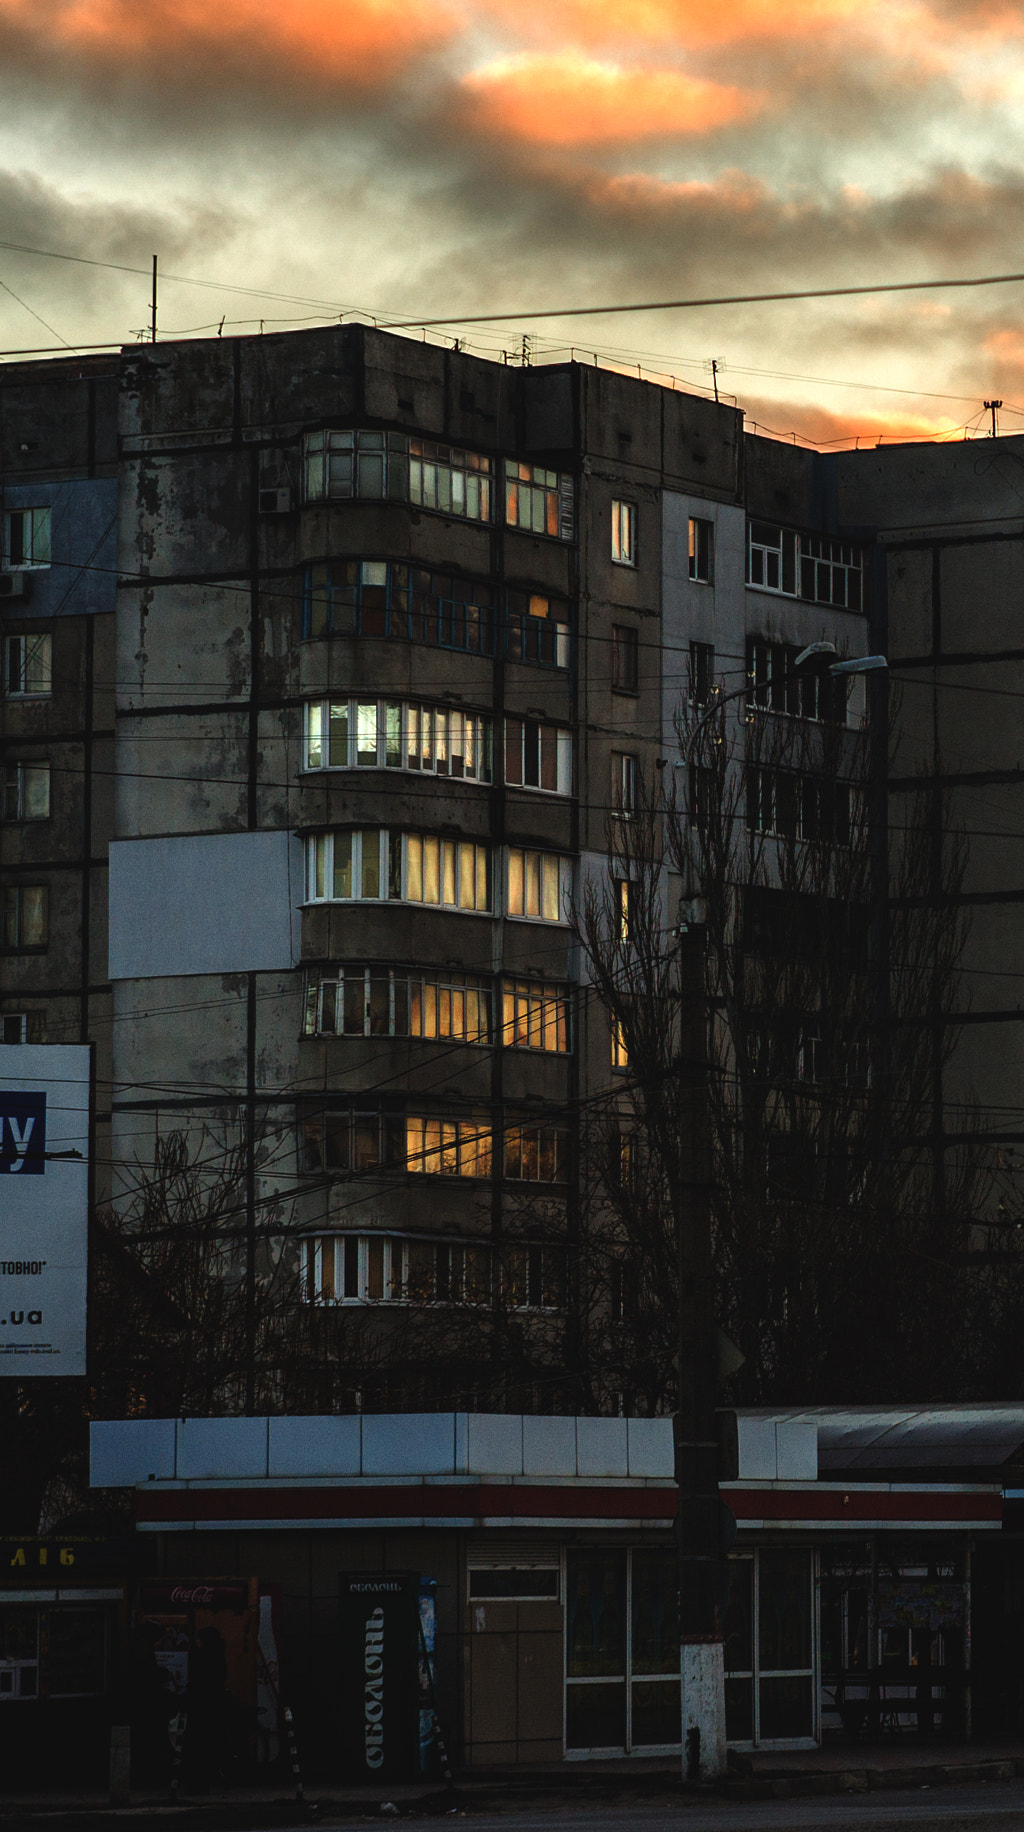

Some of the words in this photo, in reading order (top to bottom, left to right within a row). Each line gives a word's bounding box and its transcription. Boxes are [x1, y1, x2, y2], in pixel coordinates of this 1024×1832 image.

[0, 1117, 36, 1172] у
[1, 1311, 42, 1325] .ua
[364, 1607, 385, 1769] ОБОЛОНЬ
